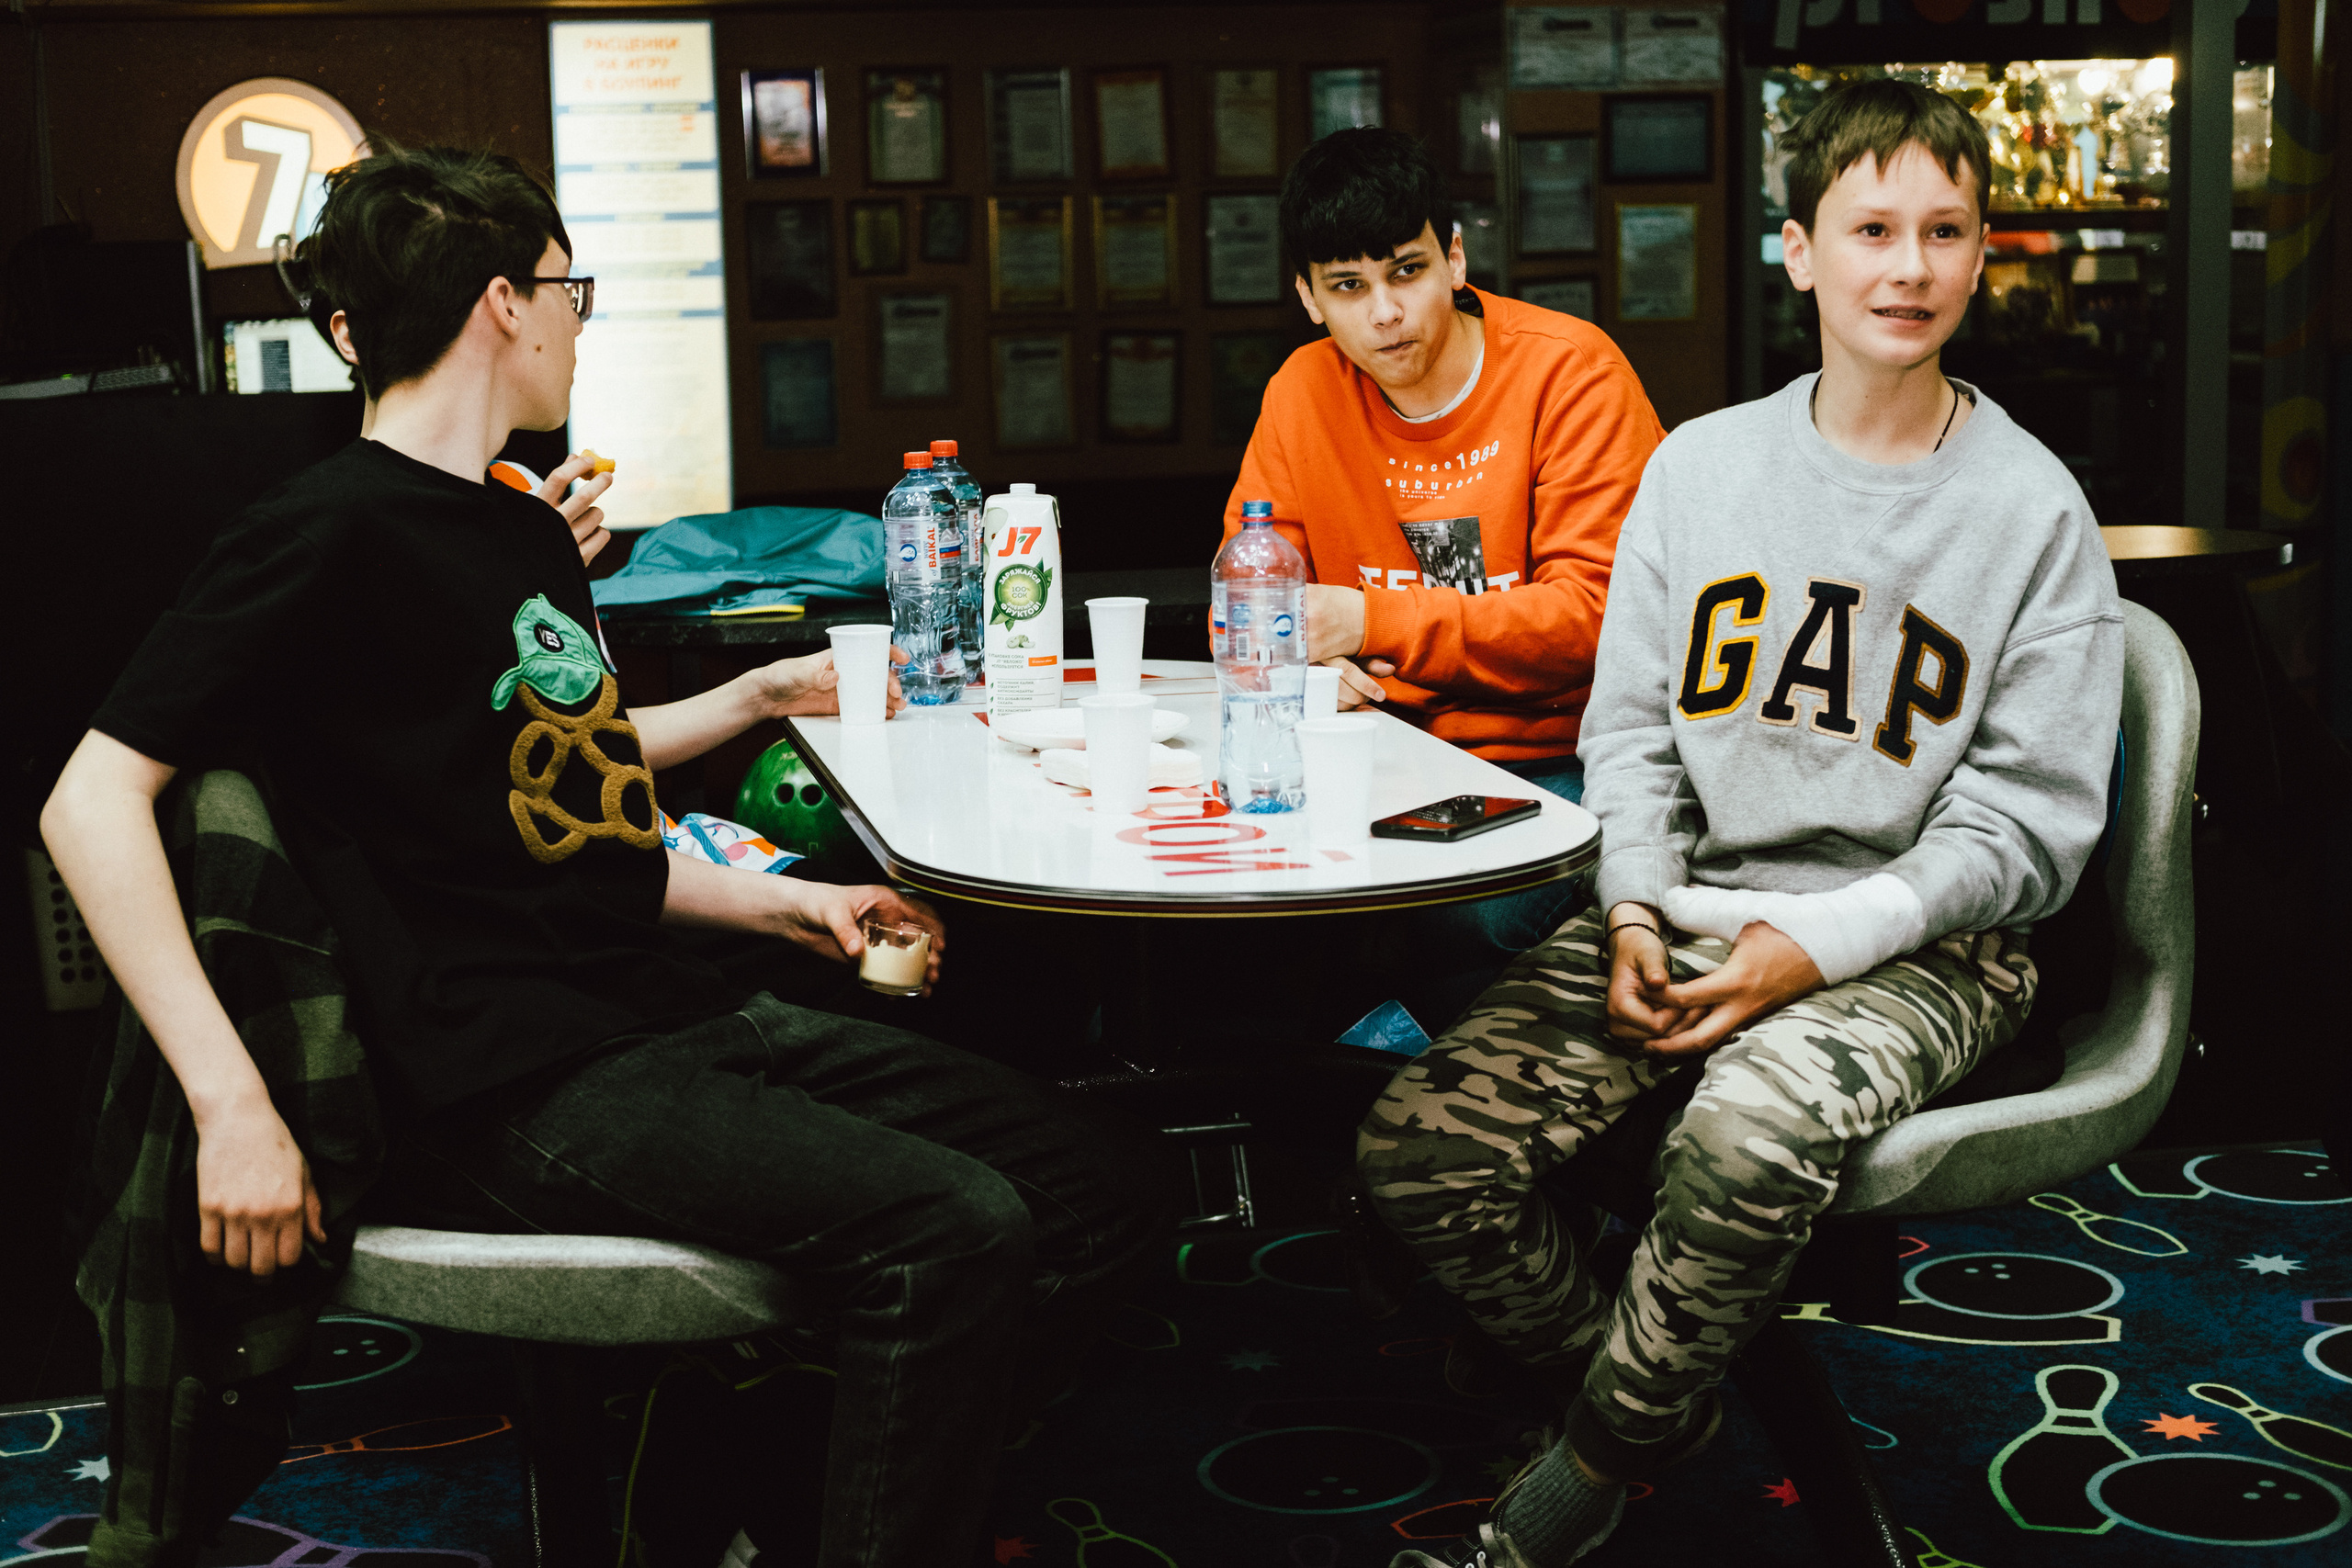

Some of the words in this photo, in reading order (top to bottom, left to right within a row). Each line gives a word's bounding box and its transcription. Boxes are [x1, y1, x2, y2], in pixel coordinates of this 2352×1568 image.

[1456, 440, 1499, 470] 1989
[1385, 471, 1483, 491] suburban
[927, 527, 937, 568] BAIKAL
[997, 526, 1042, 557] J7
[999, 568, 1042, 585] ЗАРЯЖАЙСЯ
[537, 627, 560, 649] YES
[1677, 571, 1970, 767] GAP
